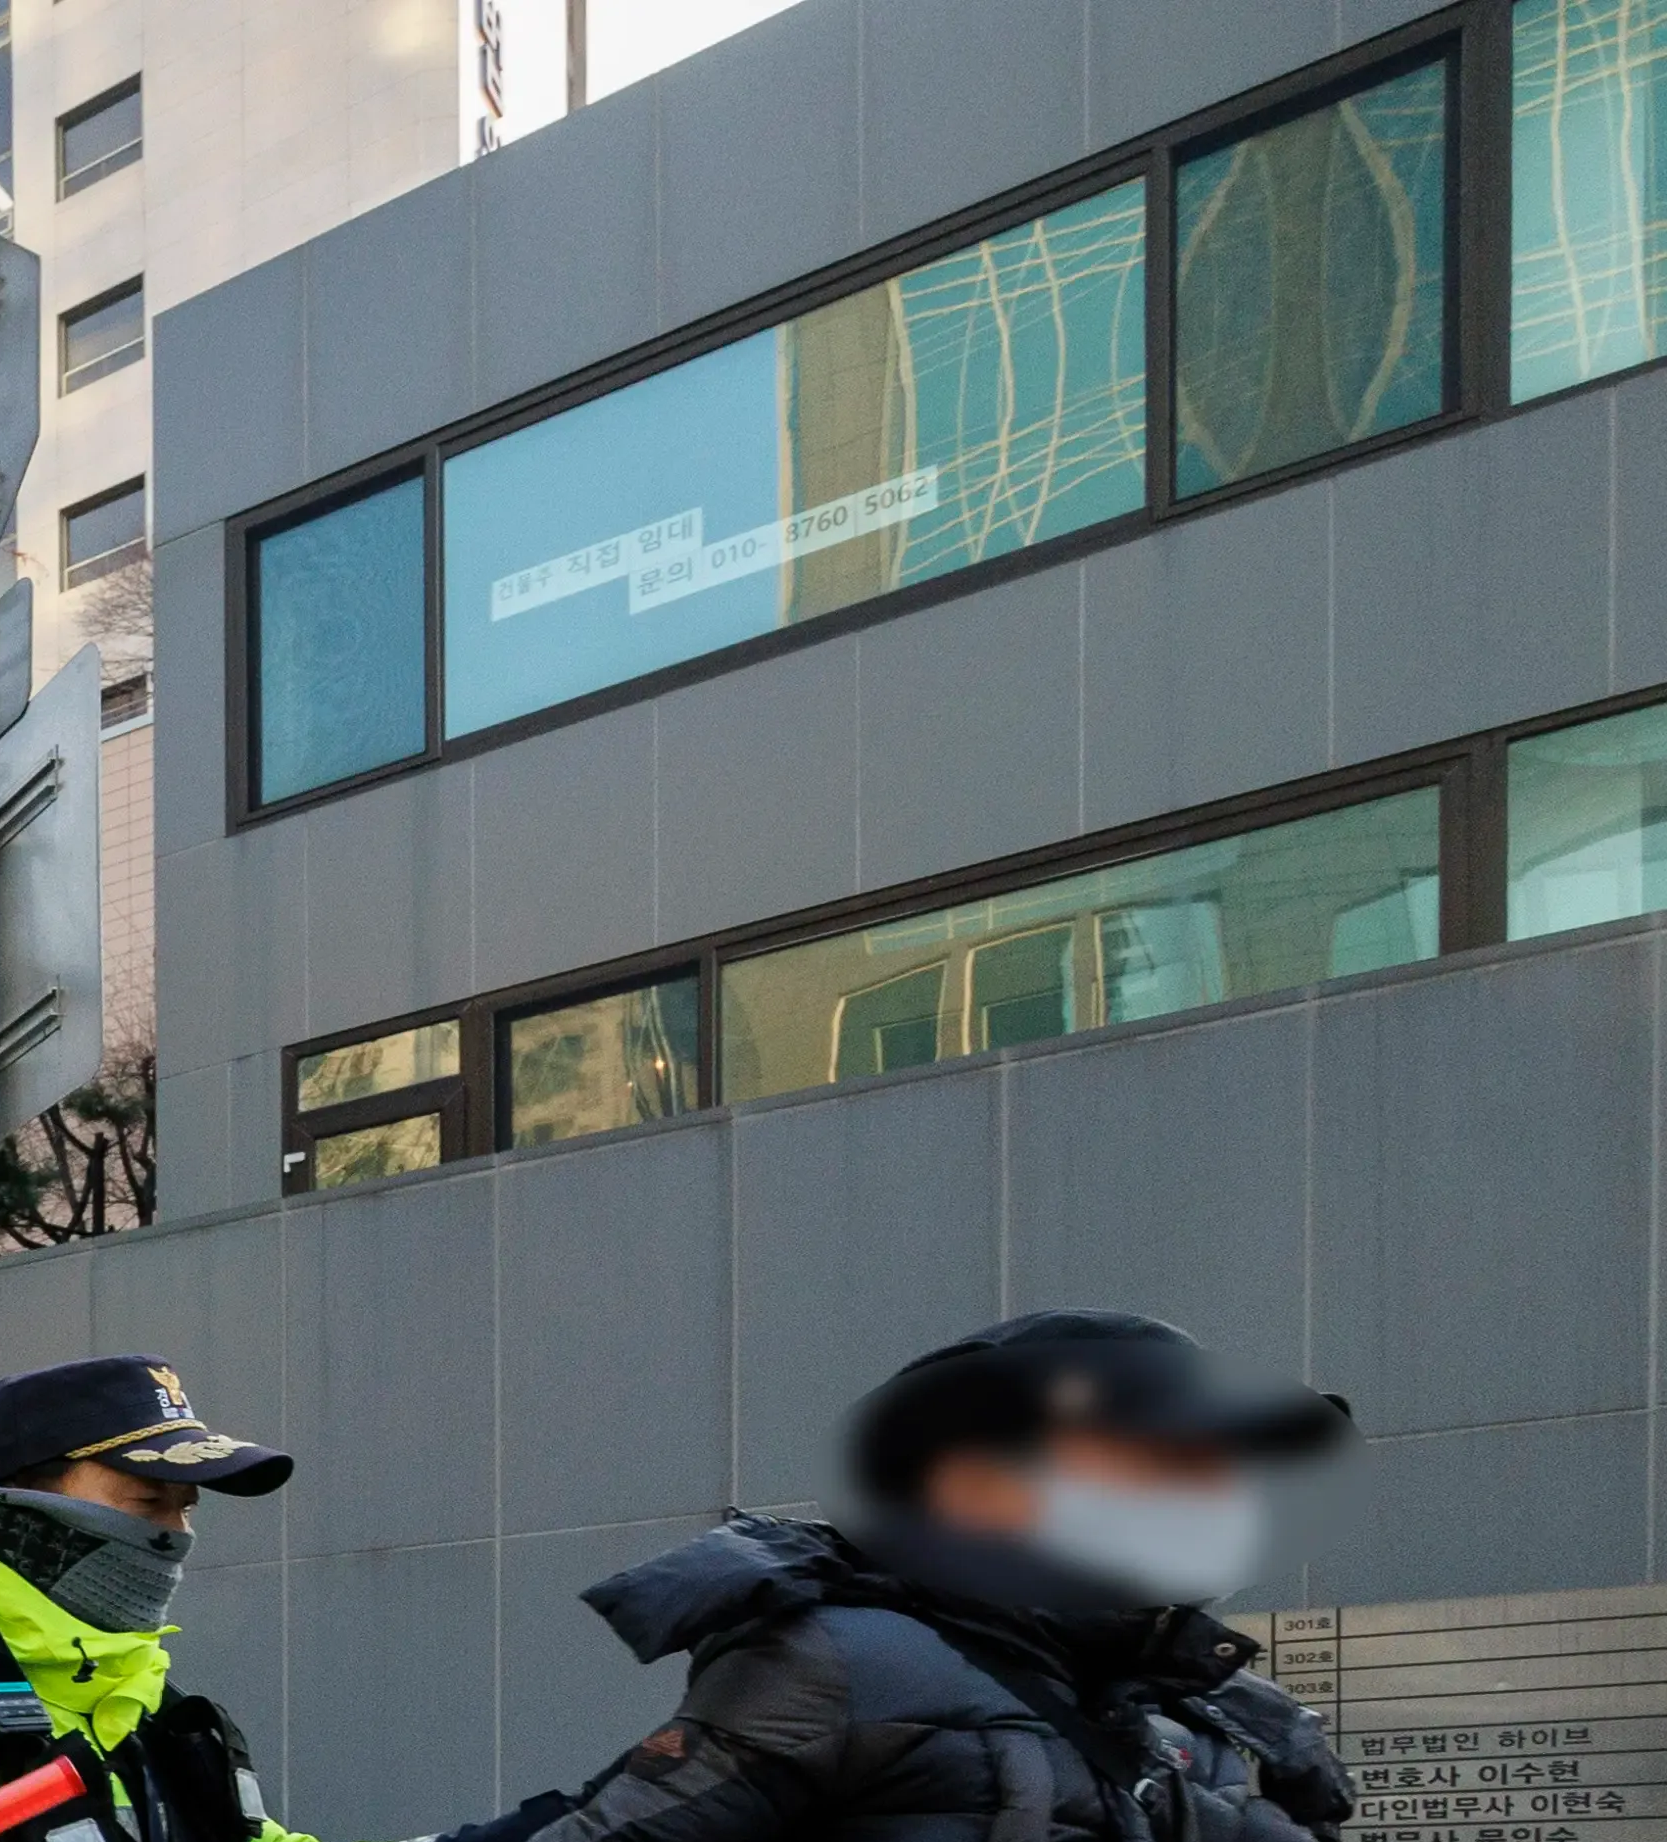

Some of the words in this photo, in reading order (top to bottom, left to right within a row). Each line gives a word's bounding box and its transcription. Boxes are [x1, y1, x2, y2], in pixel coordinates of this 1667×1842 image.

[636, 557, 695, 597] 문의
[785, 505, 849, 545] 8760
[863, 474, 928, 518] 5062
[497, 569, 553, 600] 건물주
[567, 545, 621, 576] 직접
[637, 512, 695, 555] 임대
[1360, 1732, 1480, 1757] 법무법인
[1498, 1726, 1593, 1750] 하이브
[1361, 1765, 1461, 1791] 변호사
[1478, 1759, 1581, 1786] 이수현
[1360, 1795, 1515, 1822] 다인법무사
[1530, 1790, 1626, 1815] 이현숙
